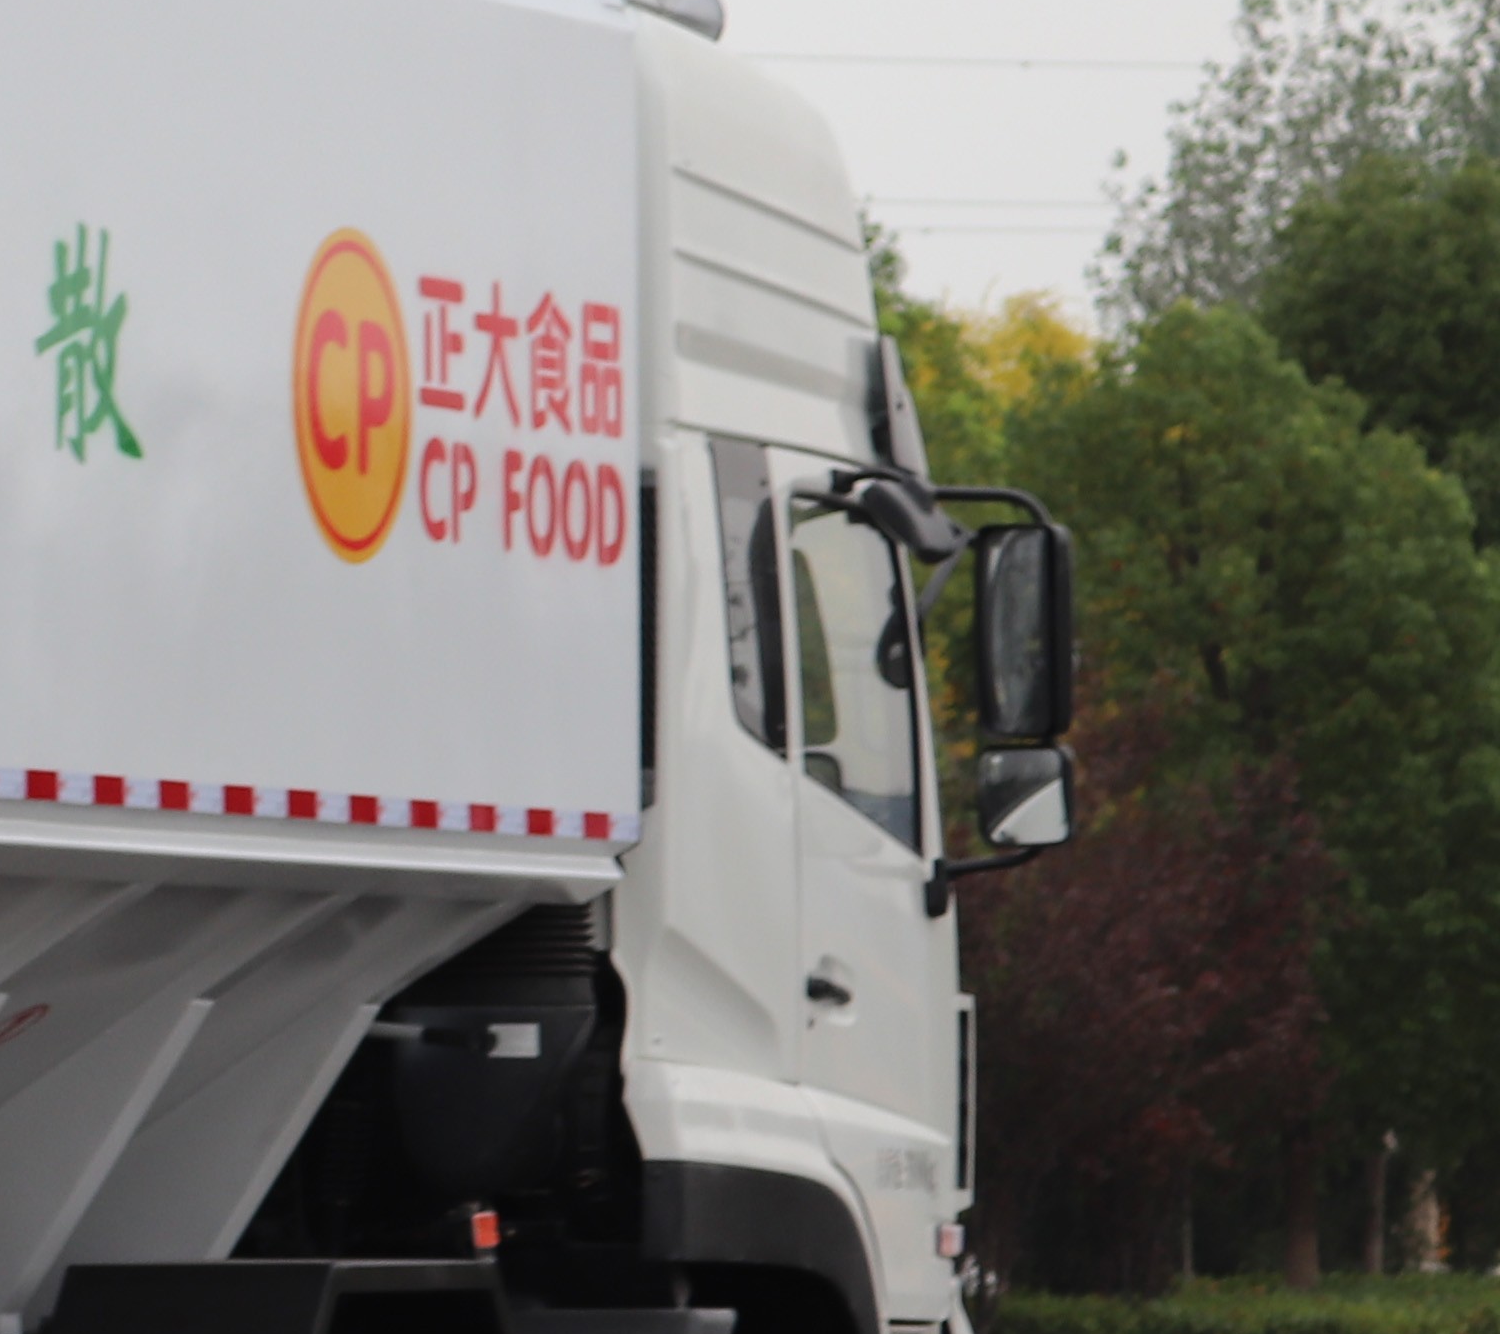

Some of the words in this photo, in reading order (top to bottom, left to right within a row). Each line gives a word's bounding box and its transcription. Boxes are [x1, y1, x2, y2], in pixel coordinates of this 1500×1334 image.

[306, 307, 396, 477] CP
[417, 275, 623, 438] 正大食品
[419, 436, 478, 544] CP
[502, 447, 627, 568] FOOD
